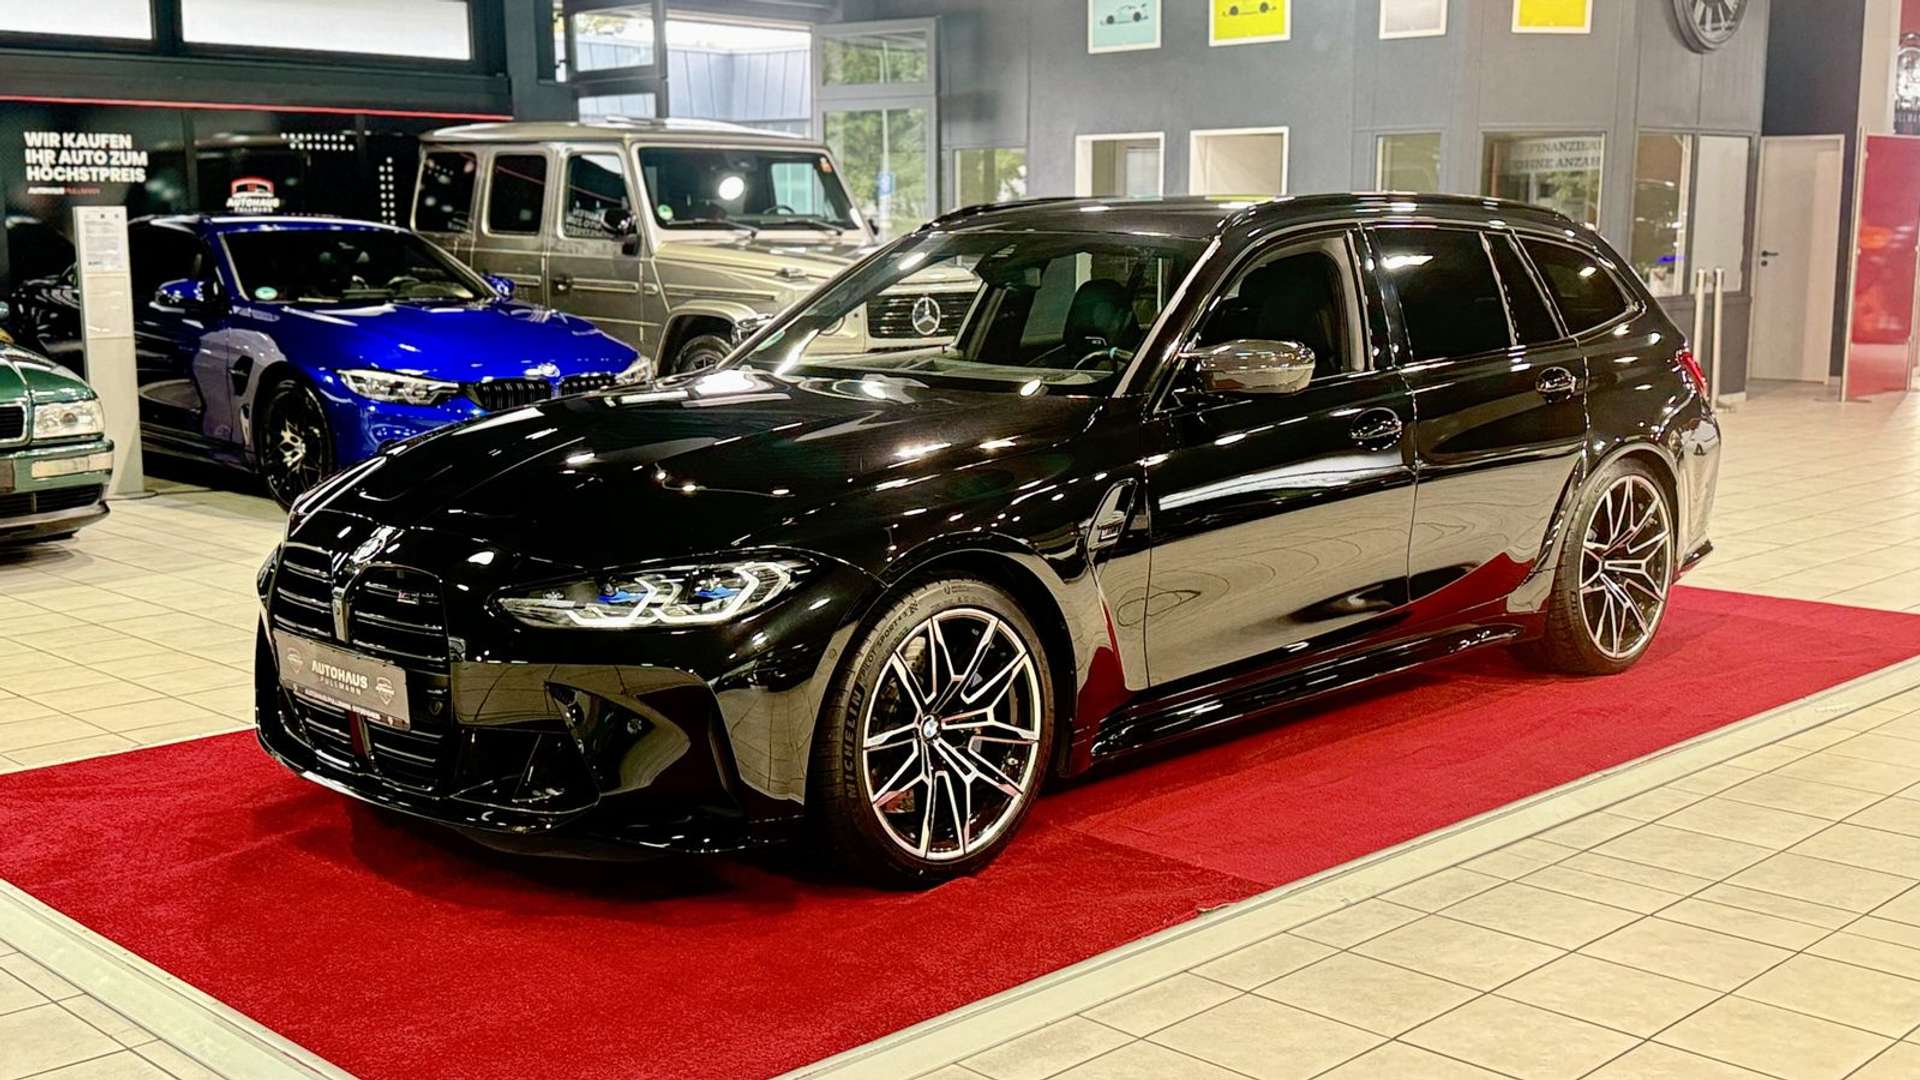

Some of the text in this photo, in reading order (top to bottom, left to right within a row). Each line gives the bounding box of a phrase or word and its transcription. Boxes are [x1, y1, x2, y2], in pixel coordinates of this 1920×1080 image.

[24, 132, 132, 149] WIR KAUFEN
[25, 149, 149, 167] IHR AUTO ZUM
[26, 164, 147, 183] HÖCHSTPREIS
[311, 660, 368, 689] AUTOHAUS
[843, 689, 862, 799] MICHELIN
